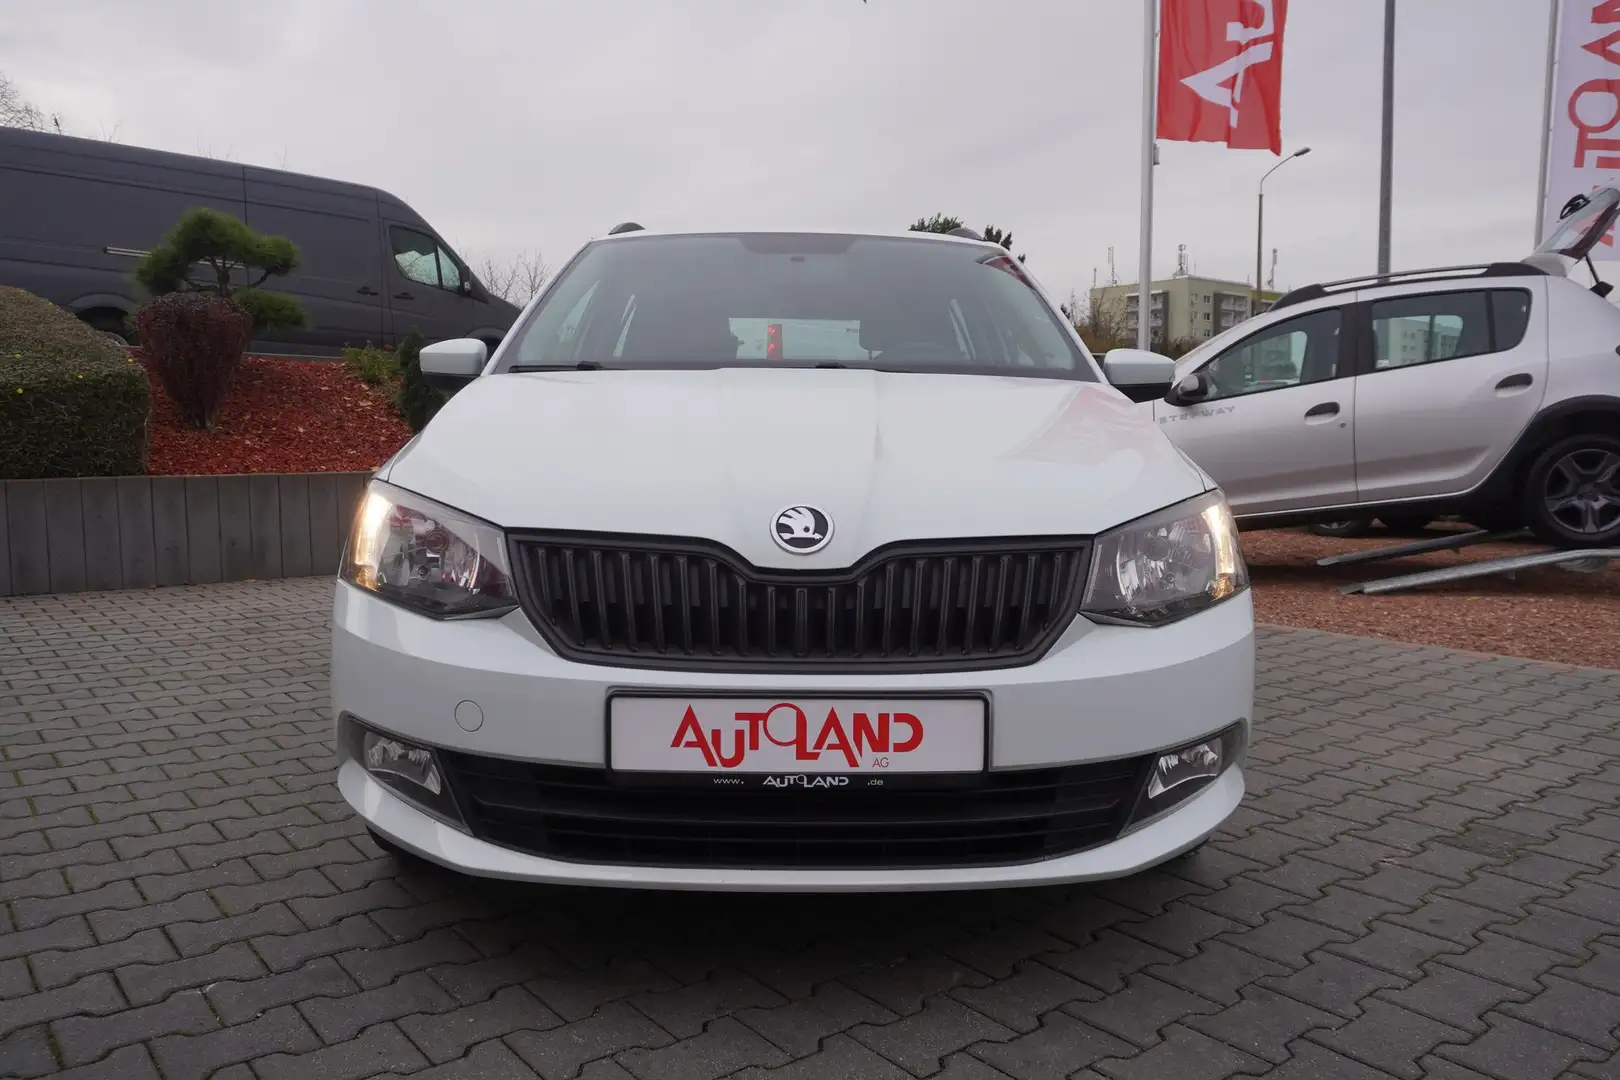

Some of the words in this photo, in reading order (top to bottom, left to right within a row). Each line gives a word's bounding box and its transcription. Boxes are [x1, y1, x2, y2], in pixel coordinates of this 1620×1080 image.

[670, 702, 924, 768] AUTOLAND
[872, 757, 890, 769] AG
[762, 774, 849, 788] AUTOLAND
